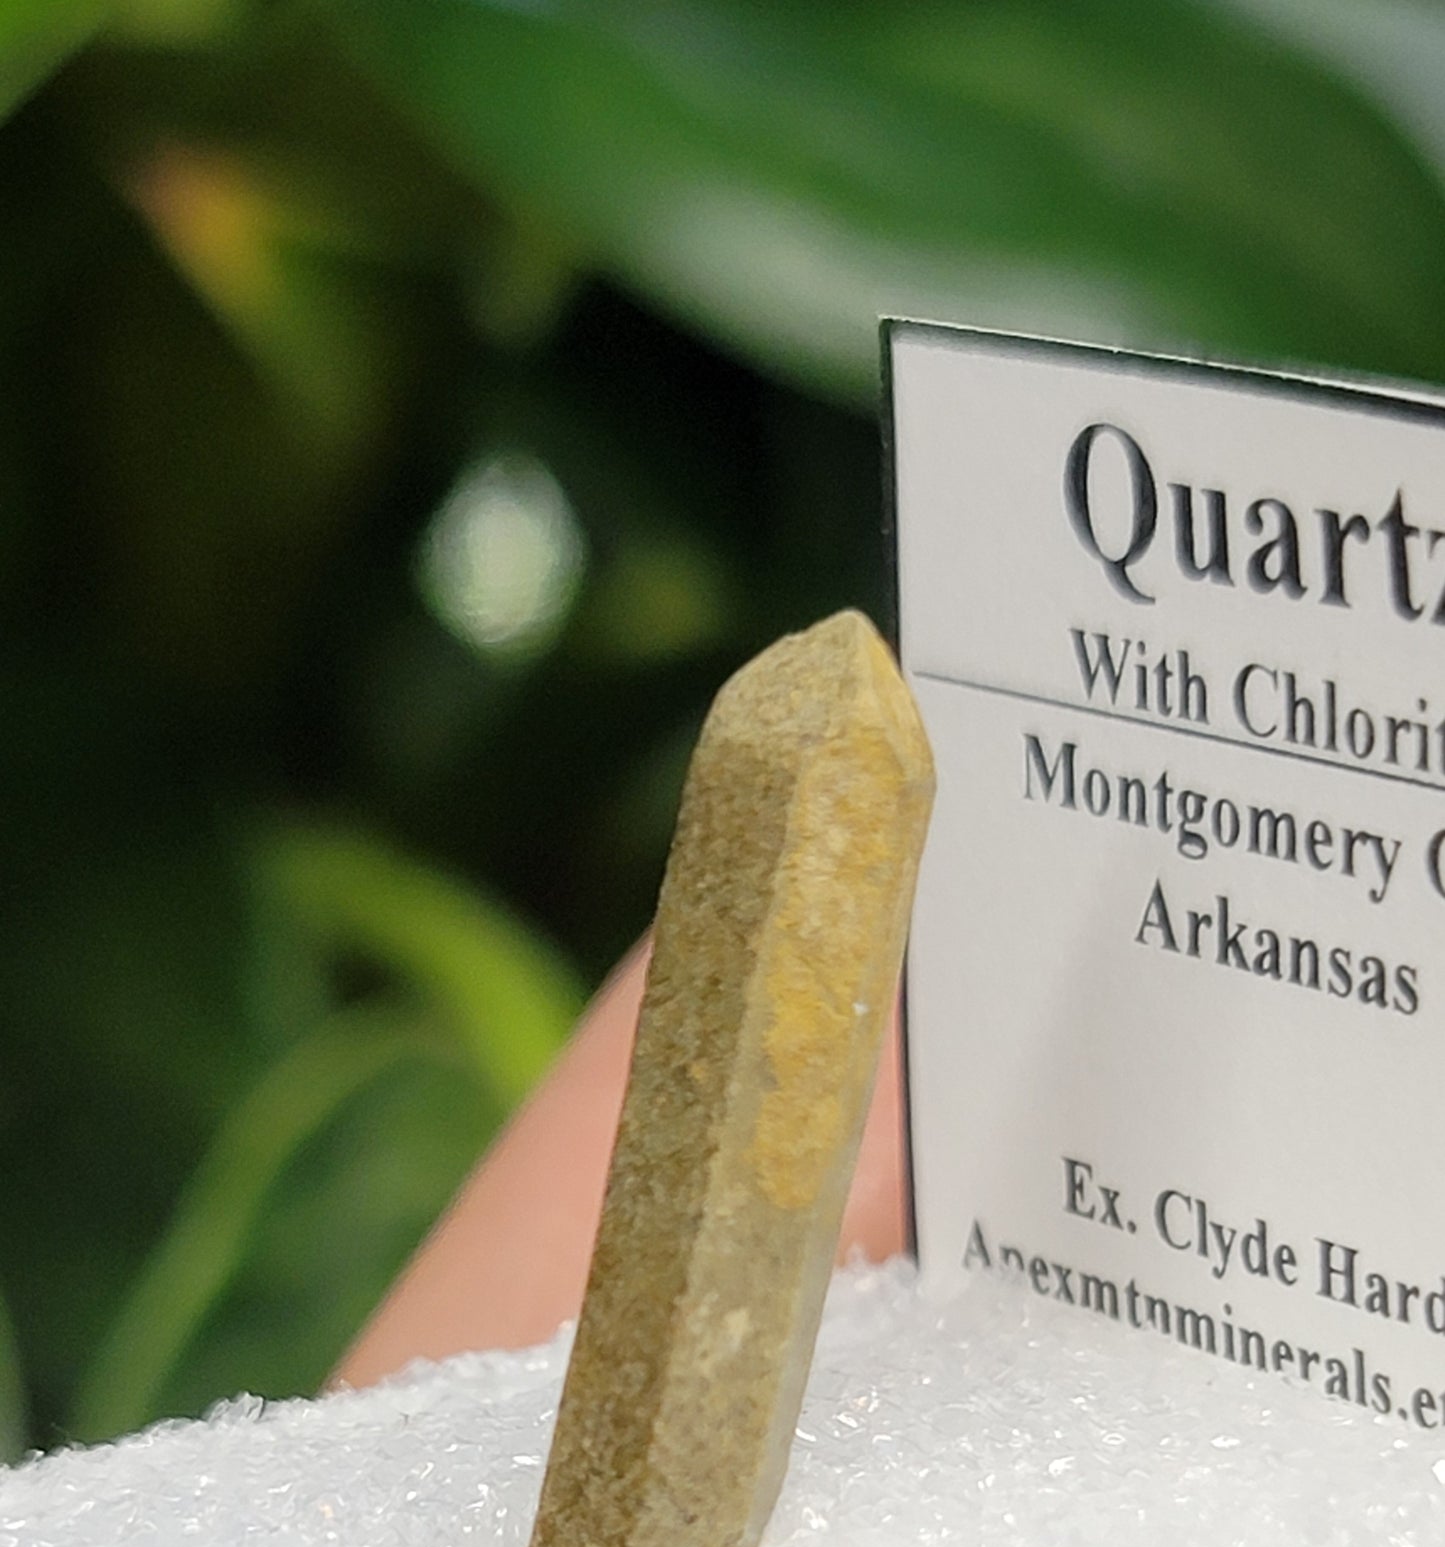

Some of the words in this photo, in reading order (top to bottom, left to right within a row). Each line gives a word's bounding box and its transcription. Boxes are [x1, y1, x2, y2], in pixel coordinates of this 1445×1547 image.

[1070, 627, 1210, 725] With
[1022, 732, 1401, 903] Montgomery
[1135, 877, 1419, 1016] Arkansas
[1062, 1156, 1137, 1234] Ex.
[1154, 1189, 1298, 1286] Clyde
